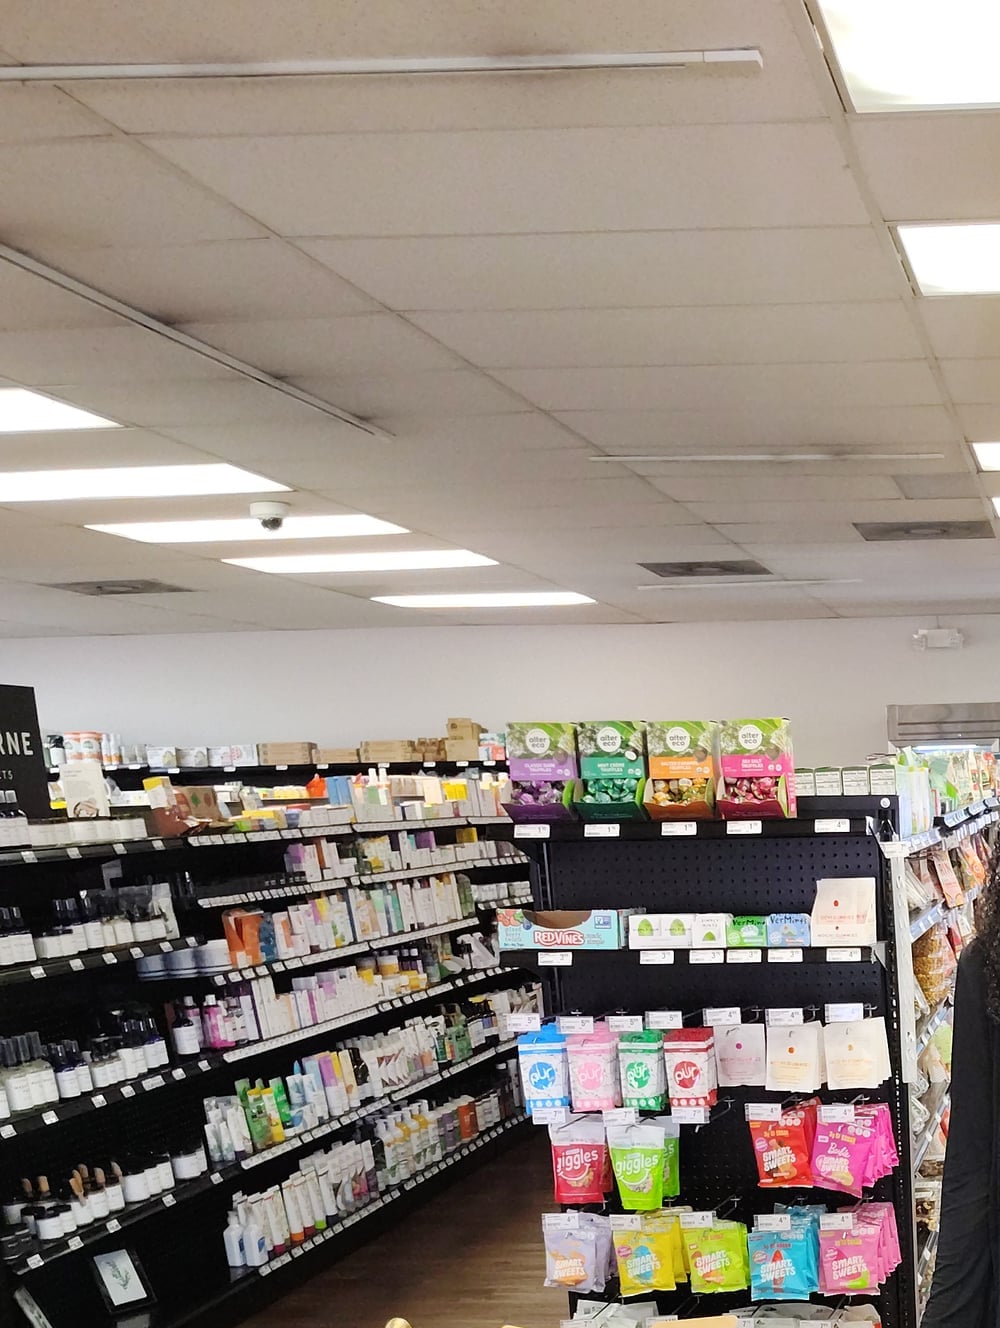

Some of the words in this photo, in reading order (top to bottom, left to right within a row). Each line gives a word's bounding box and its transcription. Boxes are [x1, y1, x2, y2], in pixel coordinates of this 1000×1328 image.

[528, 735, 547, 743] alter
[741, 731, 759, 739] alter
[557, 1148, 599, 1172] giggles
[763, 1147, 793, 1162] SMART
[615, 1152, 659, 1177] giggles
[763, 1154, 796, 1171] SWEETS
[760, 1259, 793, 1273] SMART
[832, 1255, 864, 1270] SMART
[761, 1266, 796, 1282] SWEETS
[833, 1262, 867, 1279] SWEETS
